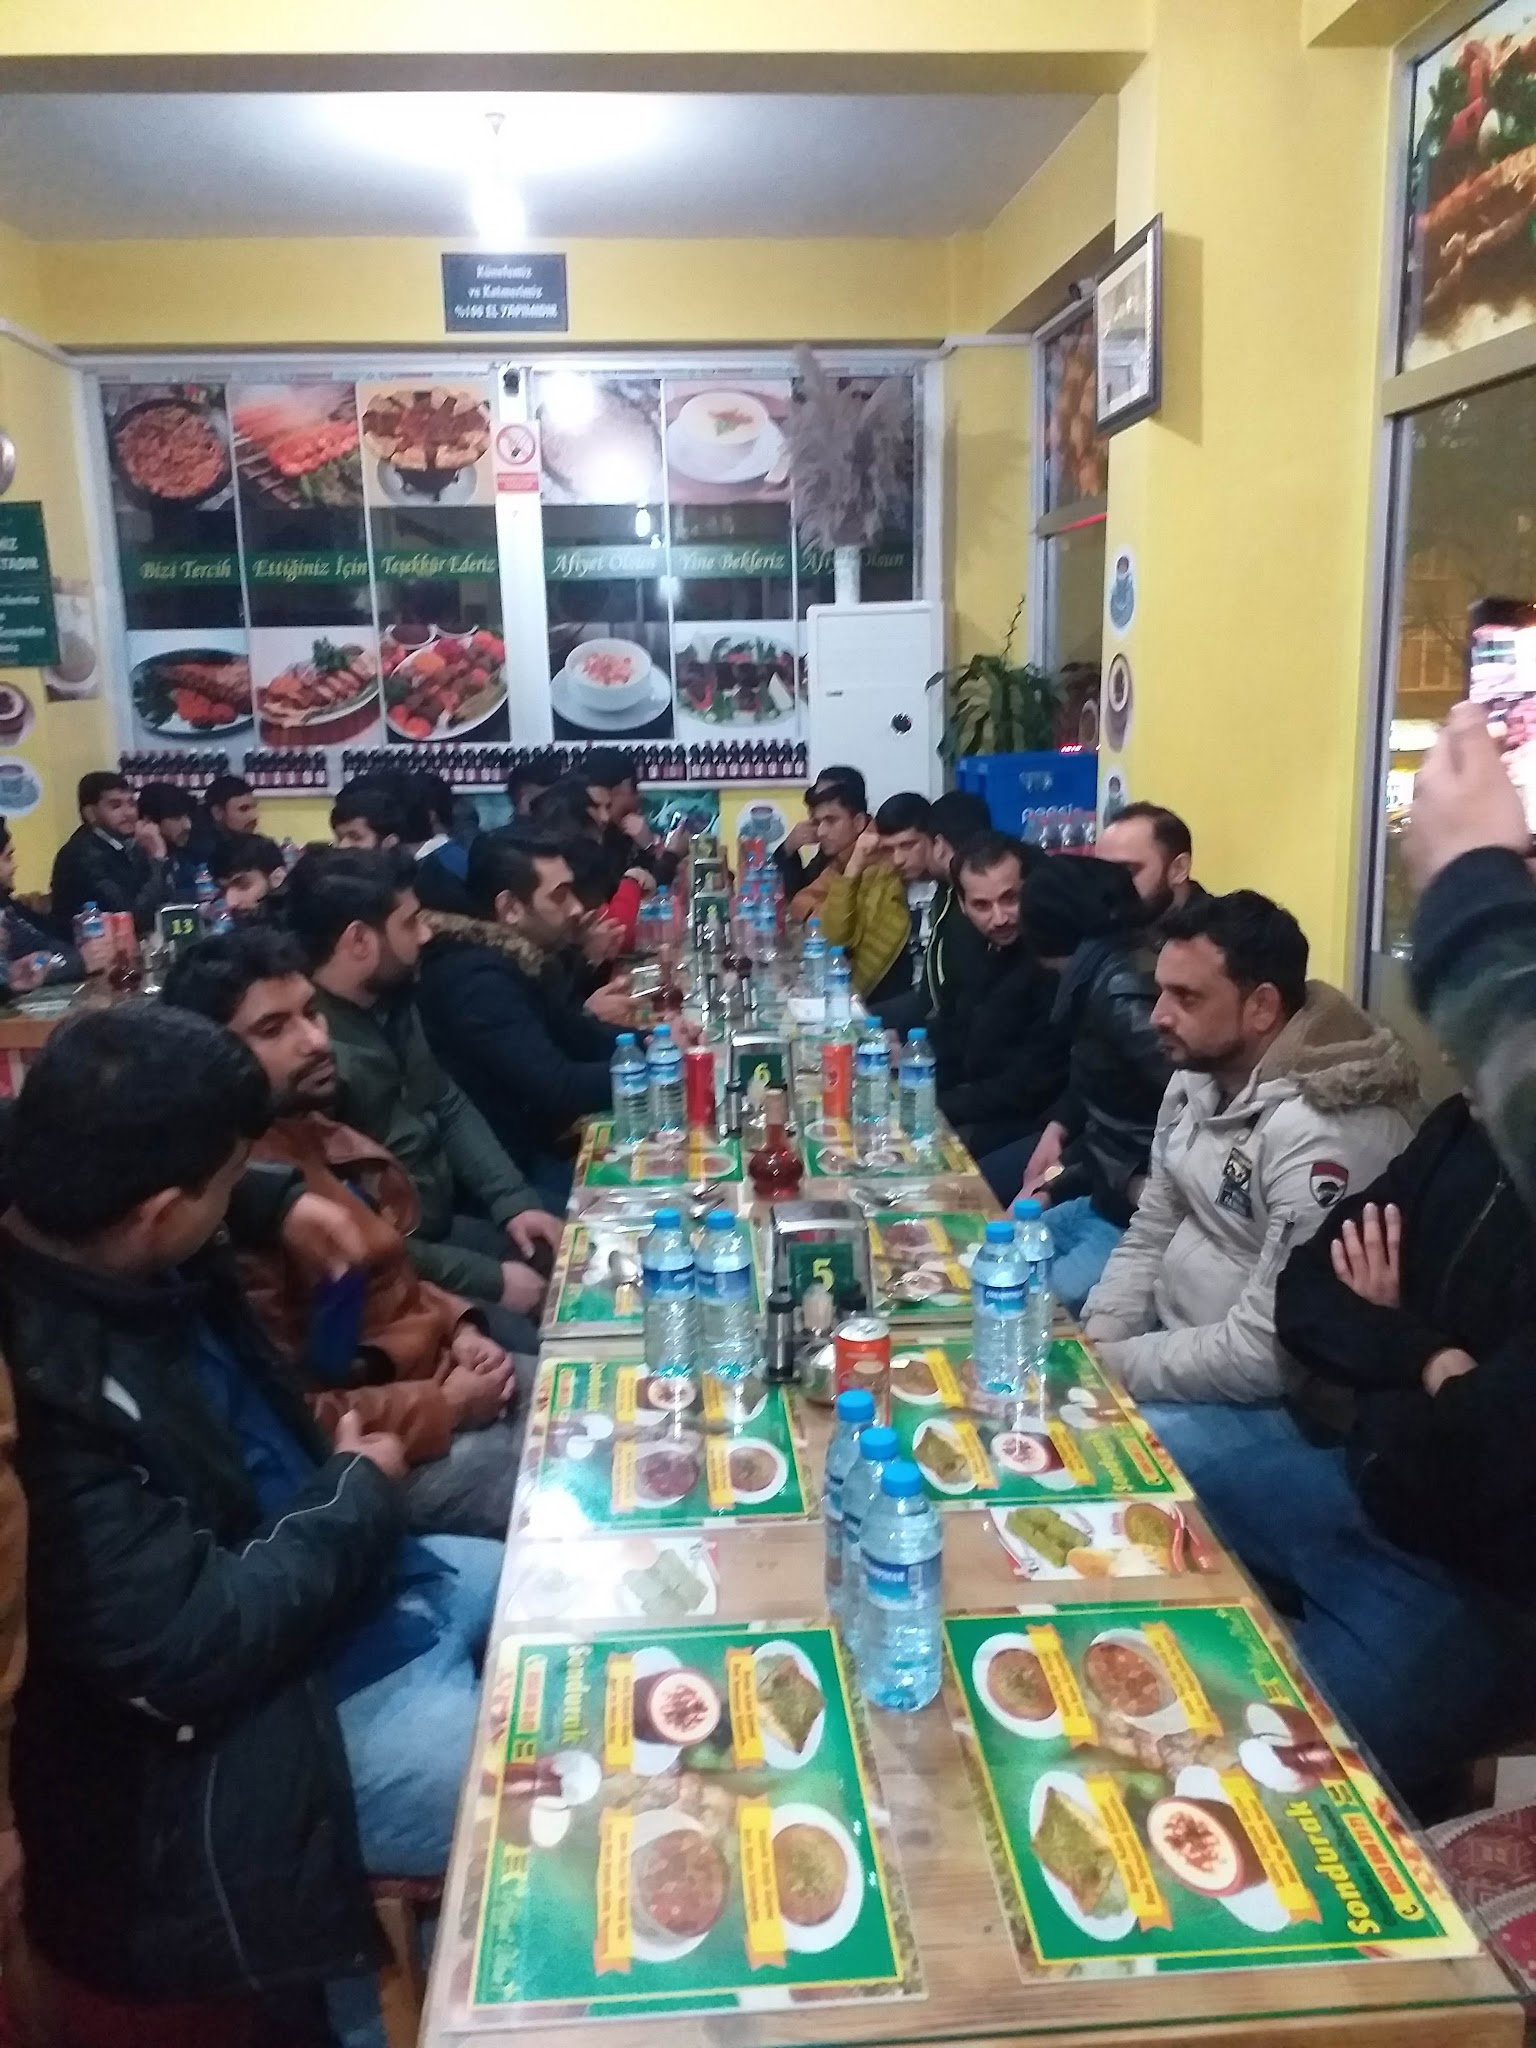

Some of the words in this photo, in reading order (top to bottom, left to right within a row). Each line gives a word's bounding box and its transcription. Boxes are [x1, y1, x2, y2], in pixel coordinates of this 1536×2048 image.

[139, 559, 177, 580] Bizi
[180, 557, 232, 579] Tercih
[252, 556, 329, 582] Ettiğiniz
[447, 551, 496, 575] Ederiz
[720, 549, 785, 575] Bekleriz
[171, 918, 194, 935] 13
[753, 1062, 772, 1088] 6
[812, 1257, 835, 1292] 5
[1284, 1799, 1381, 1935] Sondurak
